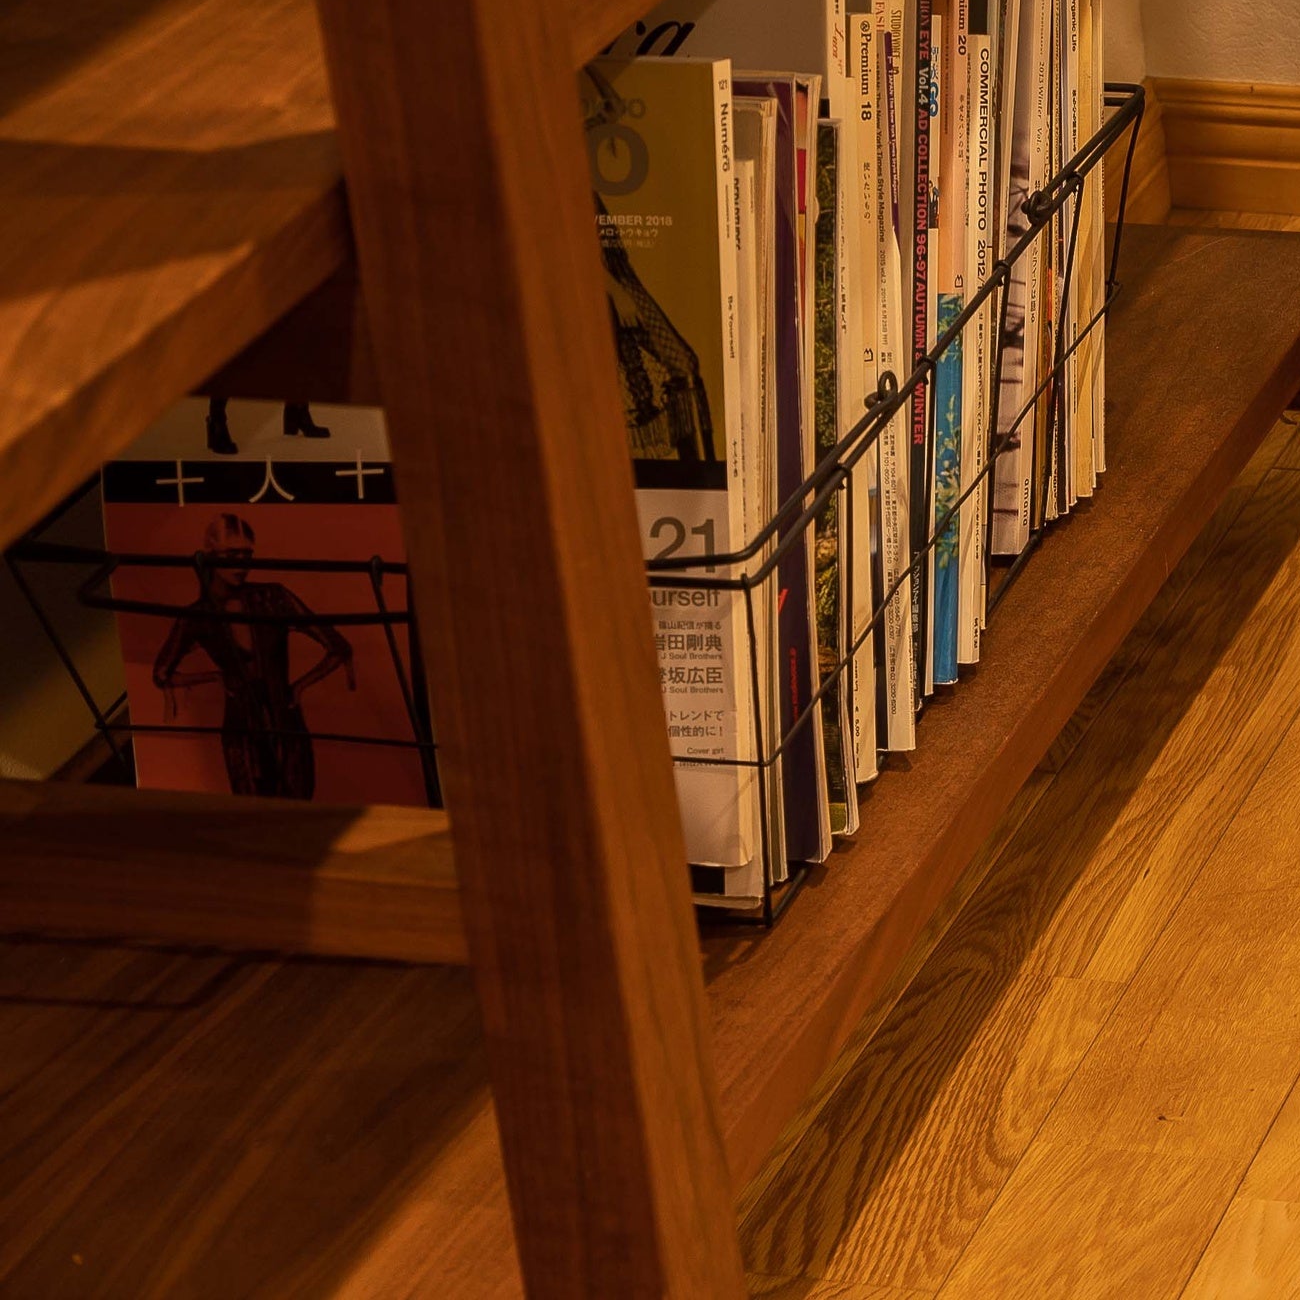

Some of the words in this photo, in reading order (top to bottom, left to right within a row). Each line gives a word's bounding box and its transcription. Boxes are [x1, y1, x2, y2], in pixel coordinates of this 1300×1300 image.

[919, 30, 930, 60] EYE
[958, 34, 966, 55] 20
[918, 66, 929, 104] Vol.4
[979, 48, 989, 167] COMMERCIAL
[861, 101, 872, 121] 18
[918, 108, 929, 130] AD
[720, 102, 731, 172] Numéro
[916, 134, 929, 230] COLLECTION
[978, 171, 987, 230] PHOTO
[645, 215, 673, 226] 2018
[916, 234, 927, 279] 96-97
[977, 240, 986, 292] 2012/1
[915, 283, 926, 349] AUTUMN
[913, 382, 925, 445] WINTER
[155, 449, 385, 508] 十人十
[1022, 478, 1030, 527] amana
[649, 516, 716, 573] 21
[712, 747, 725, 756] girl
